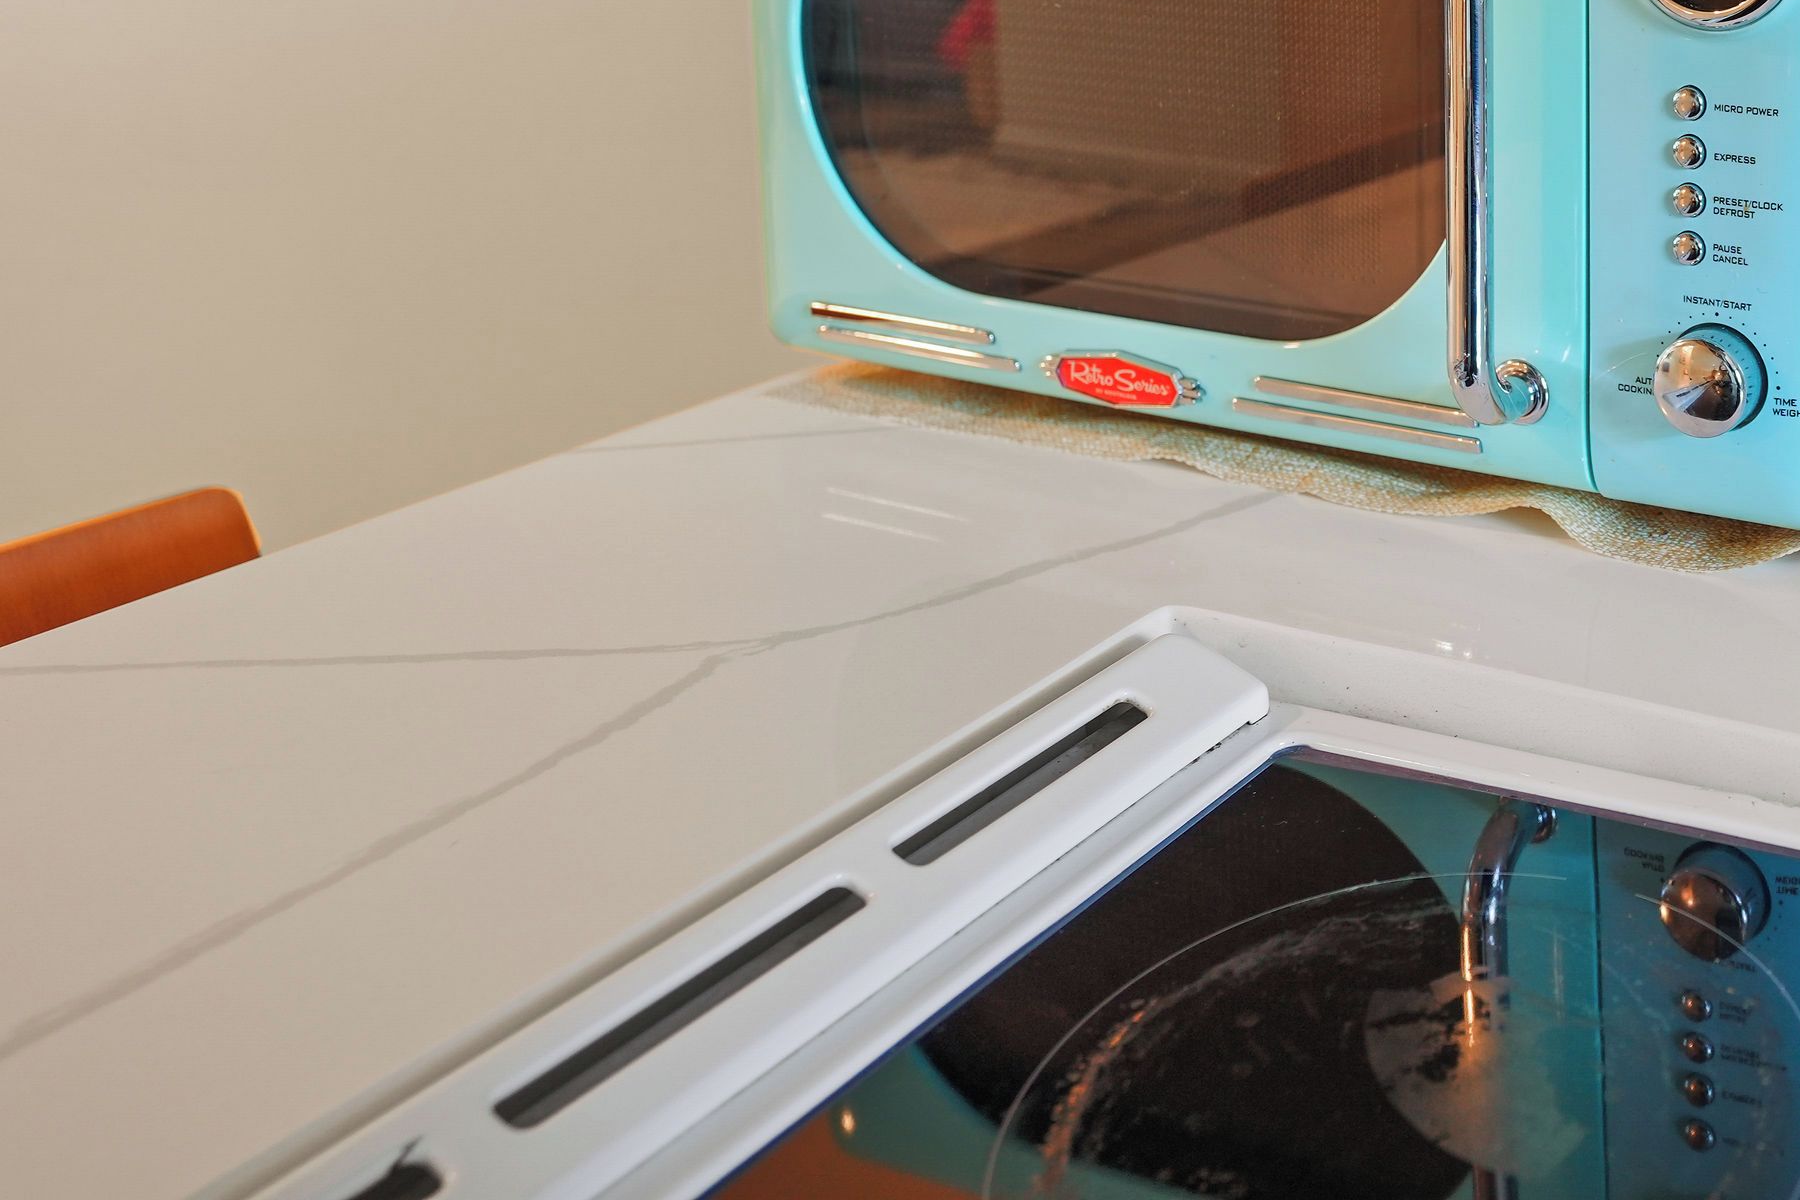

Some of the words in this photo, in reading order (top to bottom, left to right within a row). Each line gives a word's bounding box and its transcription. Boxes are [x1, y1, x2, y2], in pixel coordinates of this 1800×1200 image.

[1714, 104, 1743, 114] MICRO
[1746, 106, 1779, 117] POWER
[1714, 153, 1756, 165] EXPRESS
[1713, 196, 1784, 211] PRESET/CLOCK
[1713, 207, 1755, 219] DEFROST
[1713, 244, 1742, 255] PAUSE
[1712, 254, 1749, 266] CANCEL
[1683, 295, 1752, 311] INSTANT/START
[1067, 360, 1114, 387] Retro
[1114, 369, 1168, 397] Series
[1635, 376, 1654, 386] AUT
[1617, 383, 1654, 396] COOKIN
[1774, 397, 1797, 407] TIME
